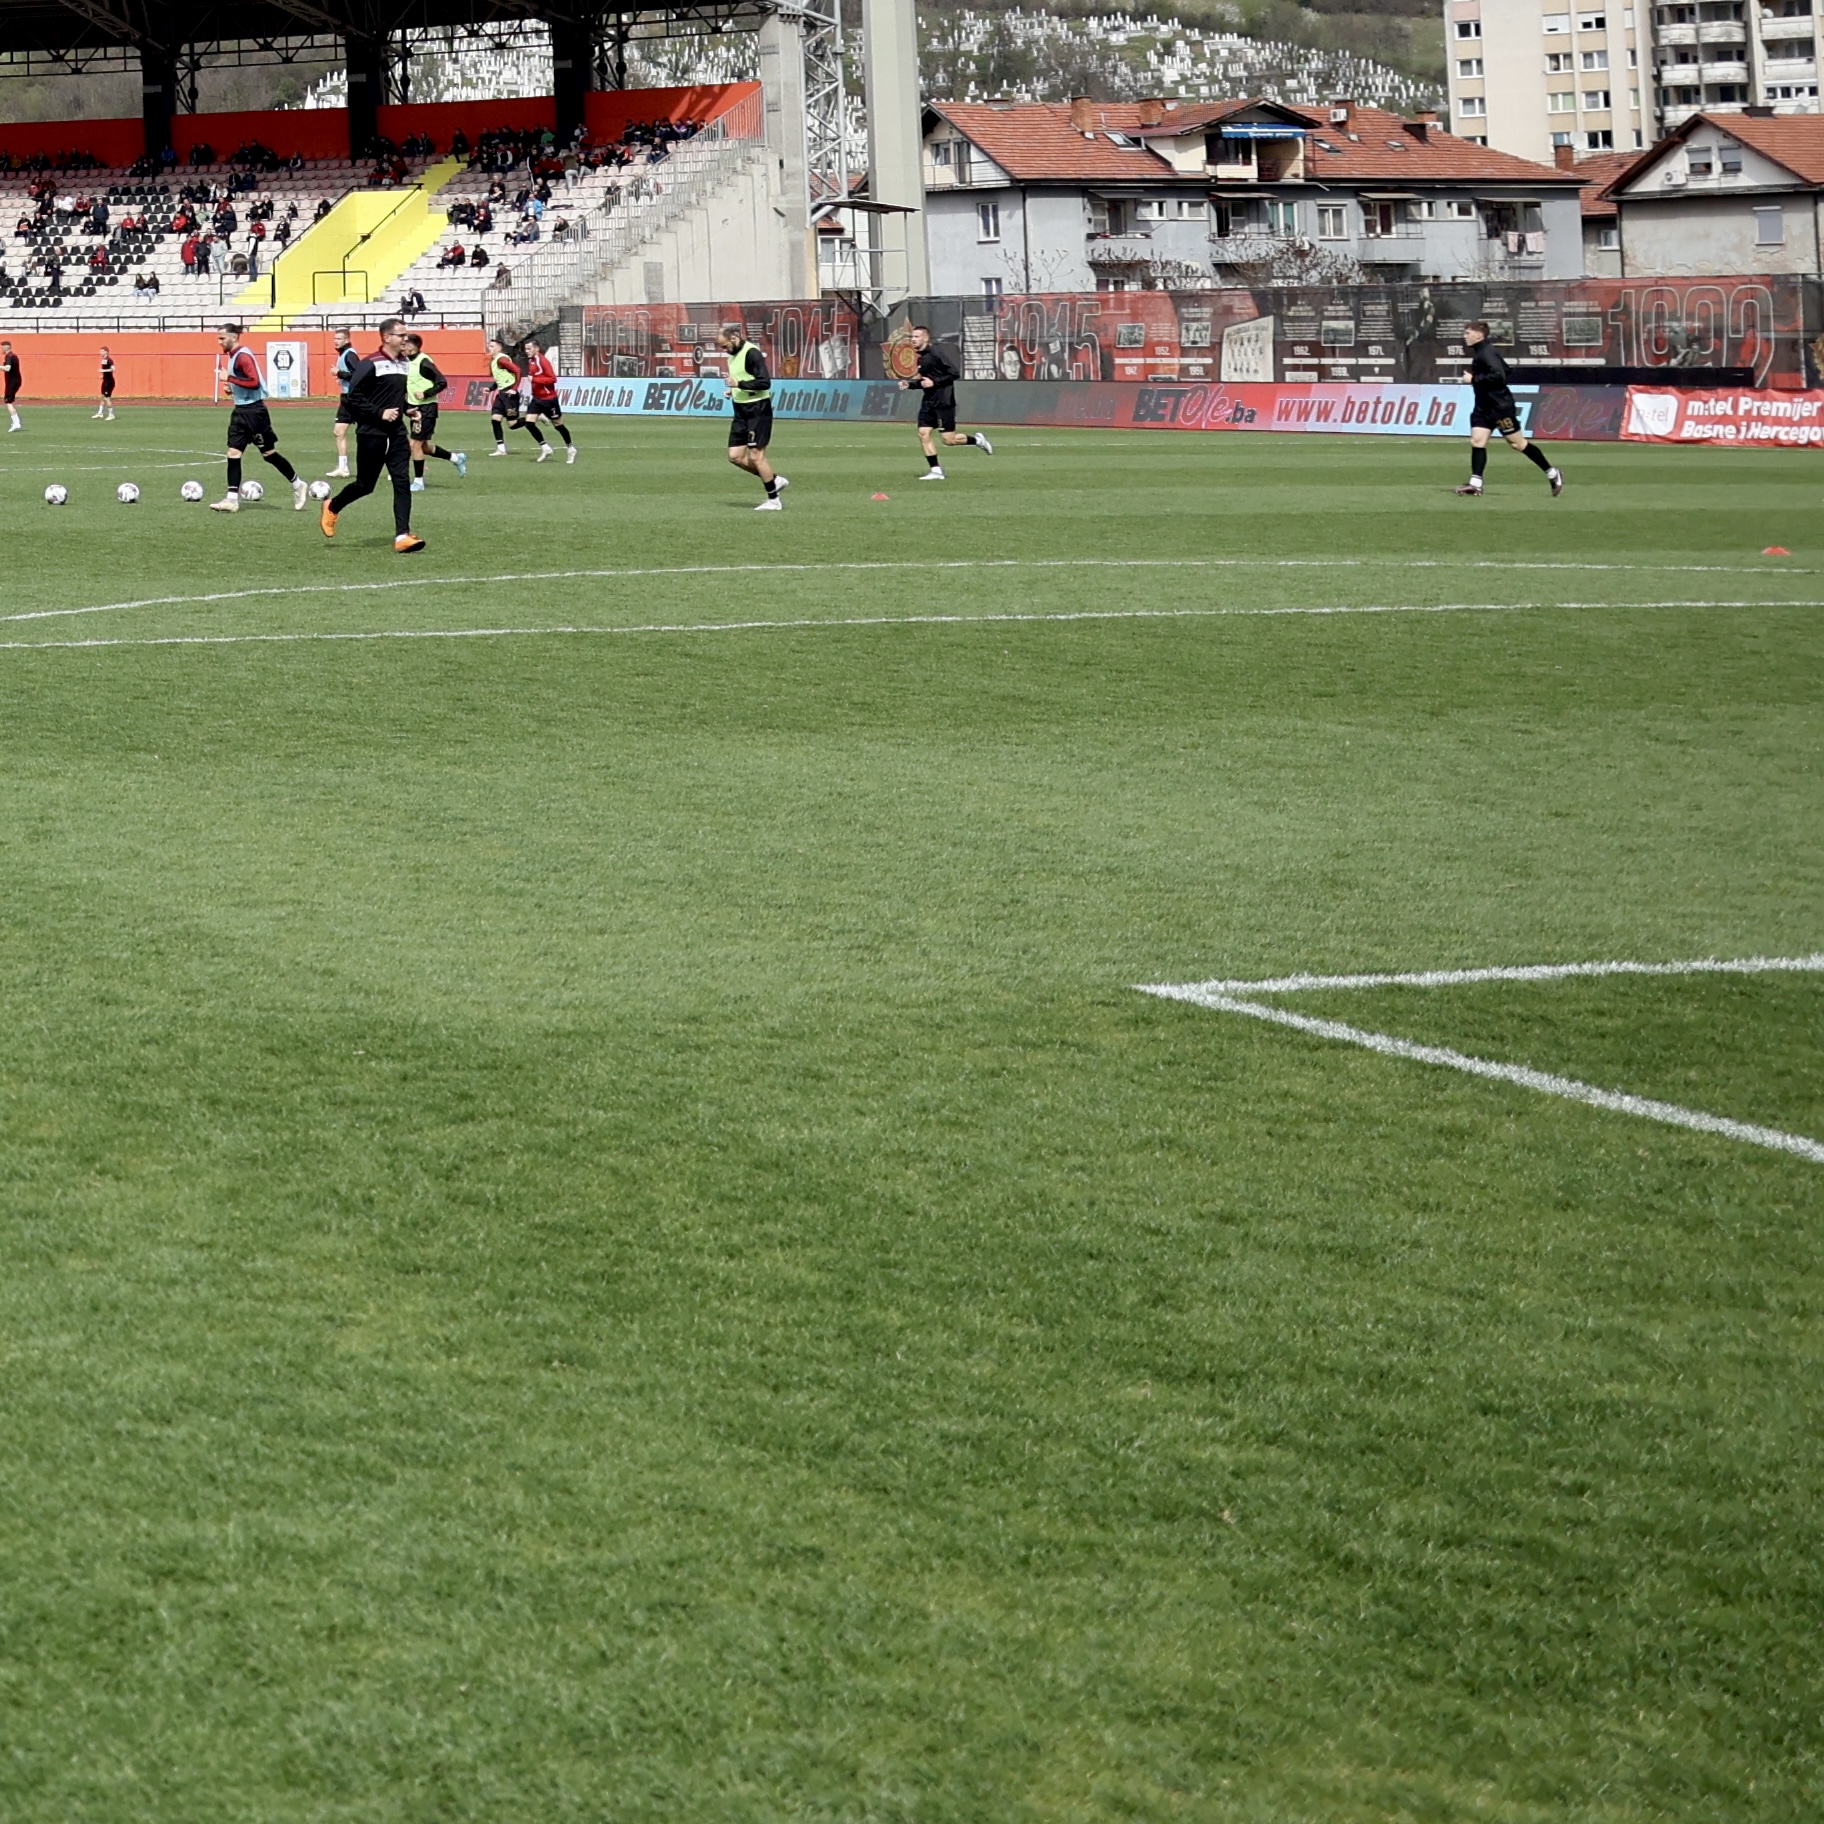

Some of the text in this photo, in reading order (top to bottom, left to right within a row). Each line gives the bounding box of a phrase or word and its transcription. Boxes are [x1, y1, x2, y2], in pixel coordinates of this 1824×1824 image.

[1276, 394, 1458, 426] www.betole.ba
[1738, 396, 1822, 422] Premijer
[1680, 420, 1737, 440] Bosne
